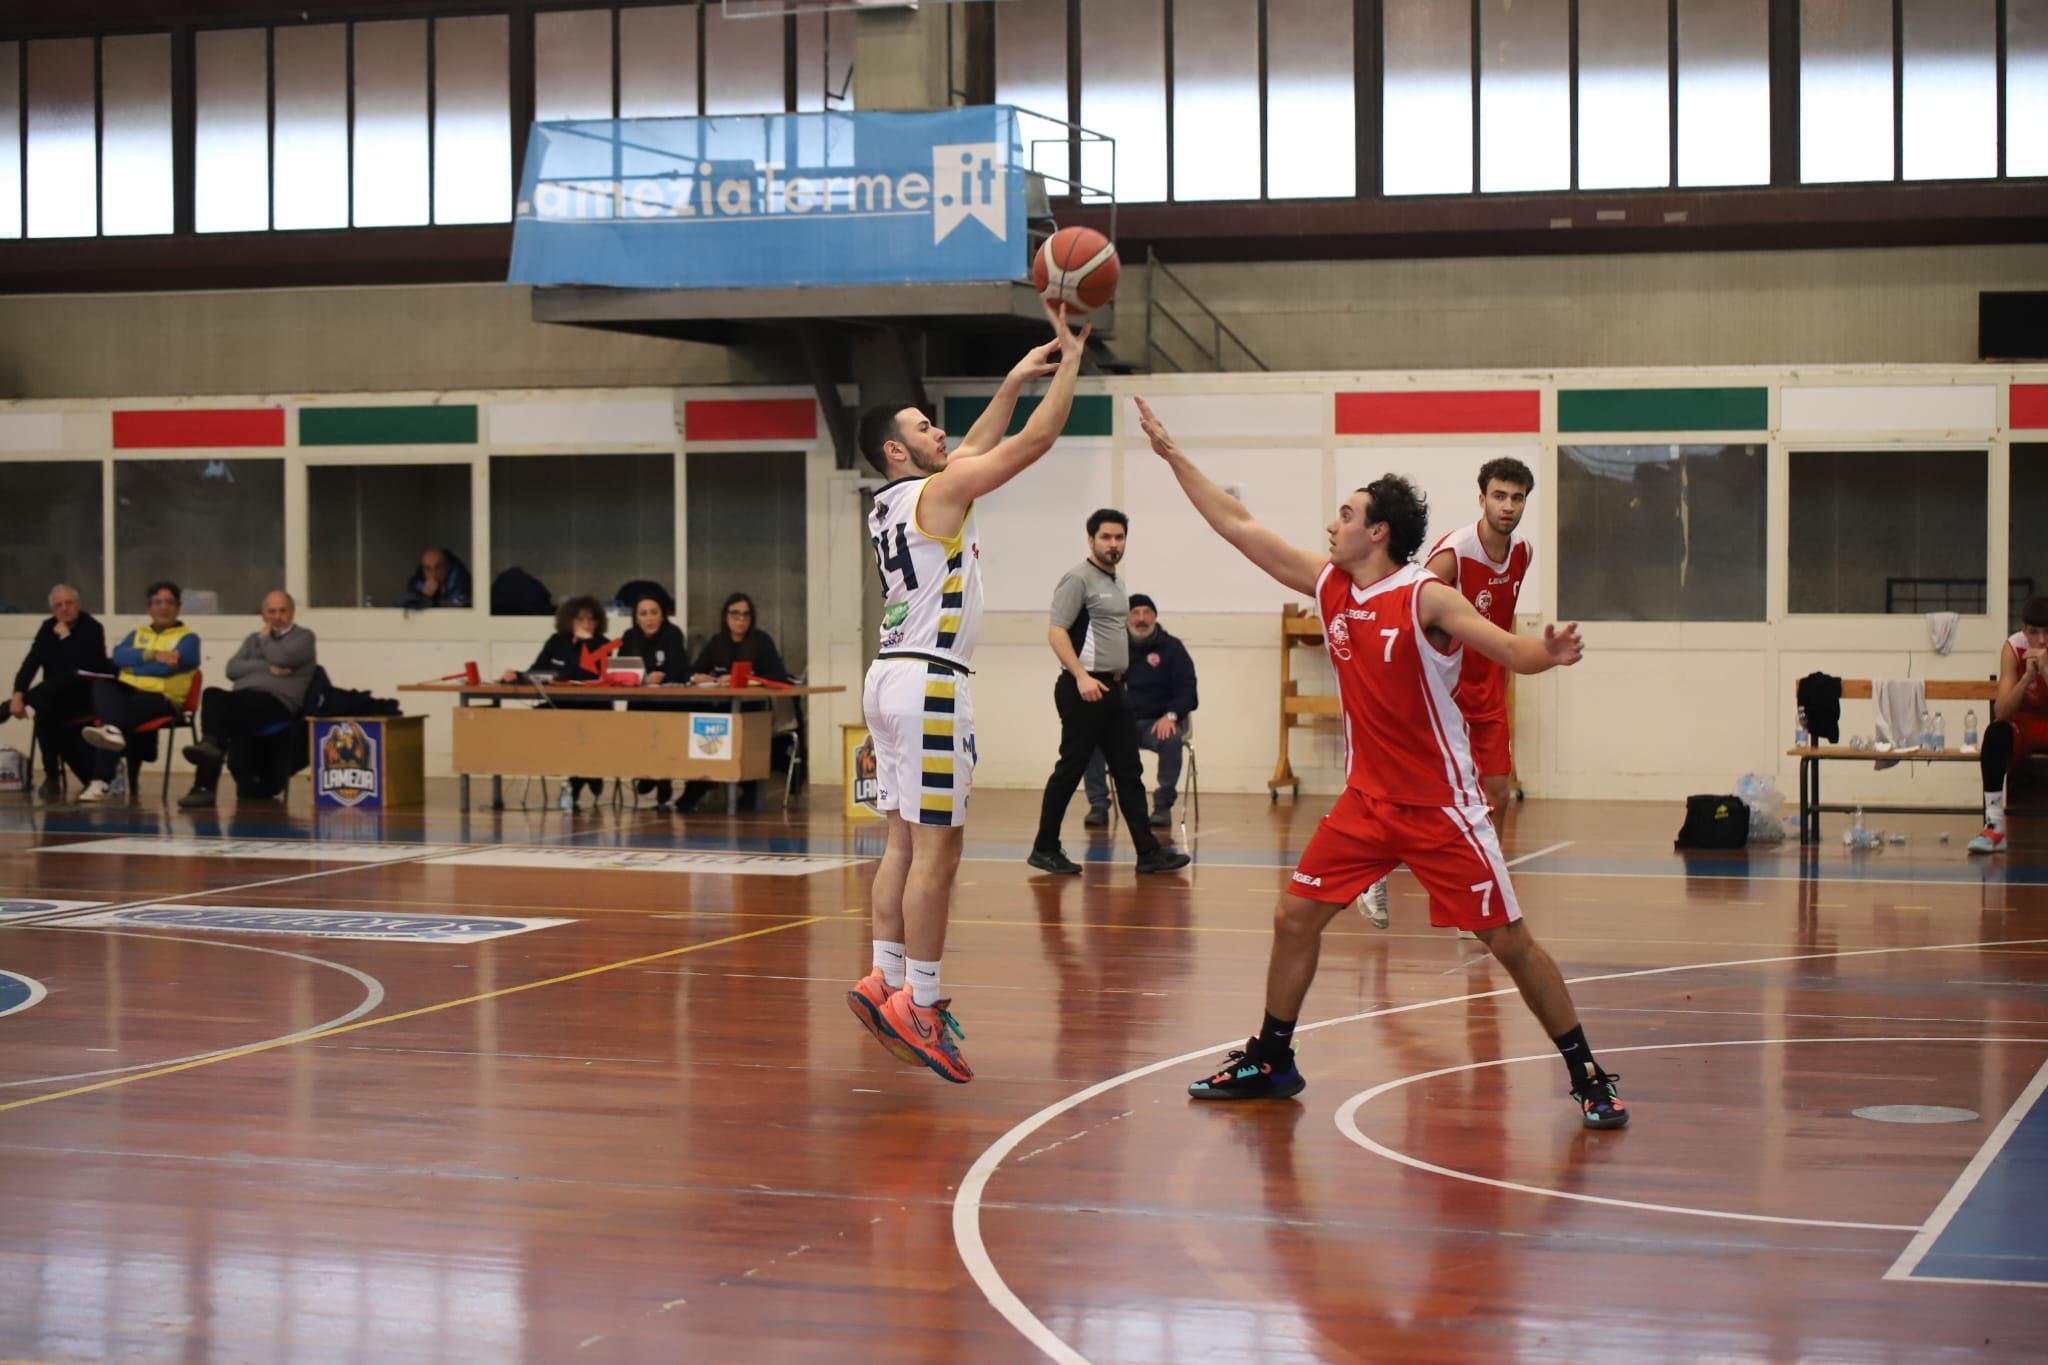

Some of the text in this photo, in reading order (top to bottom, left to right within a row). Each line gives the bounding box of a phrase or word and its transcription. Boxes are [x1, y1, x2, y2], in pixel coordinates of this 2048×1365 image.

[1380, 628, 1399, 662] 7
[323, 768, 374, 790] LAMEZIA
[1470, 879, 1494, 917] 7
